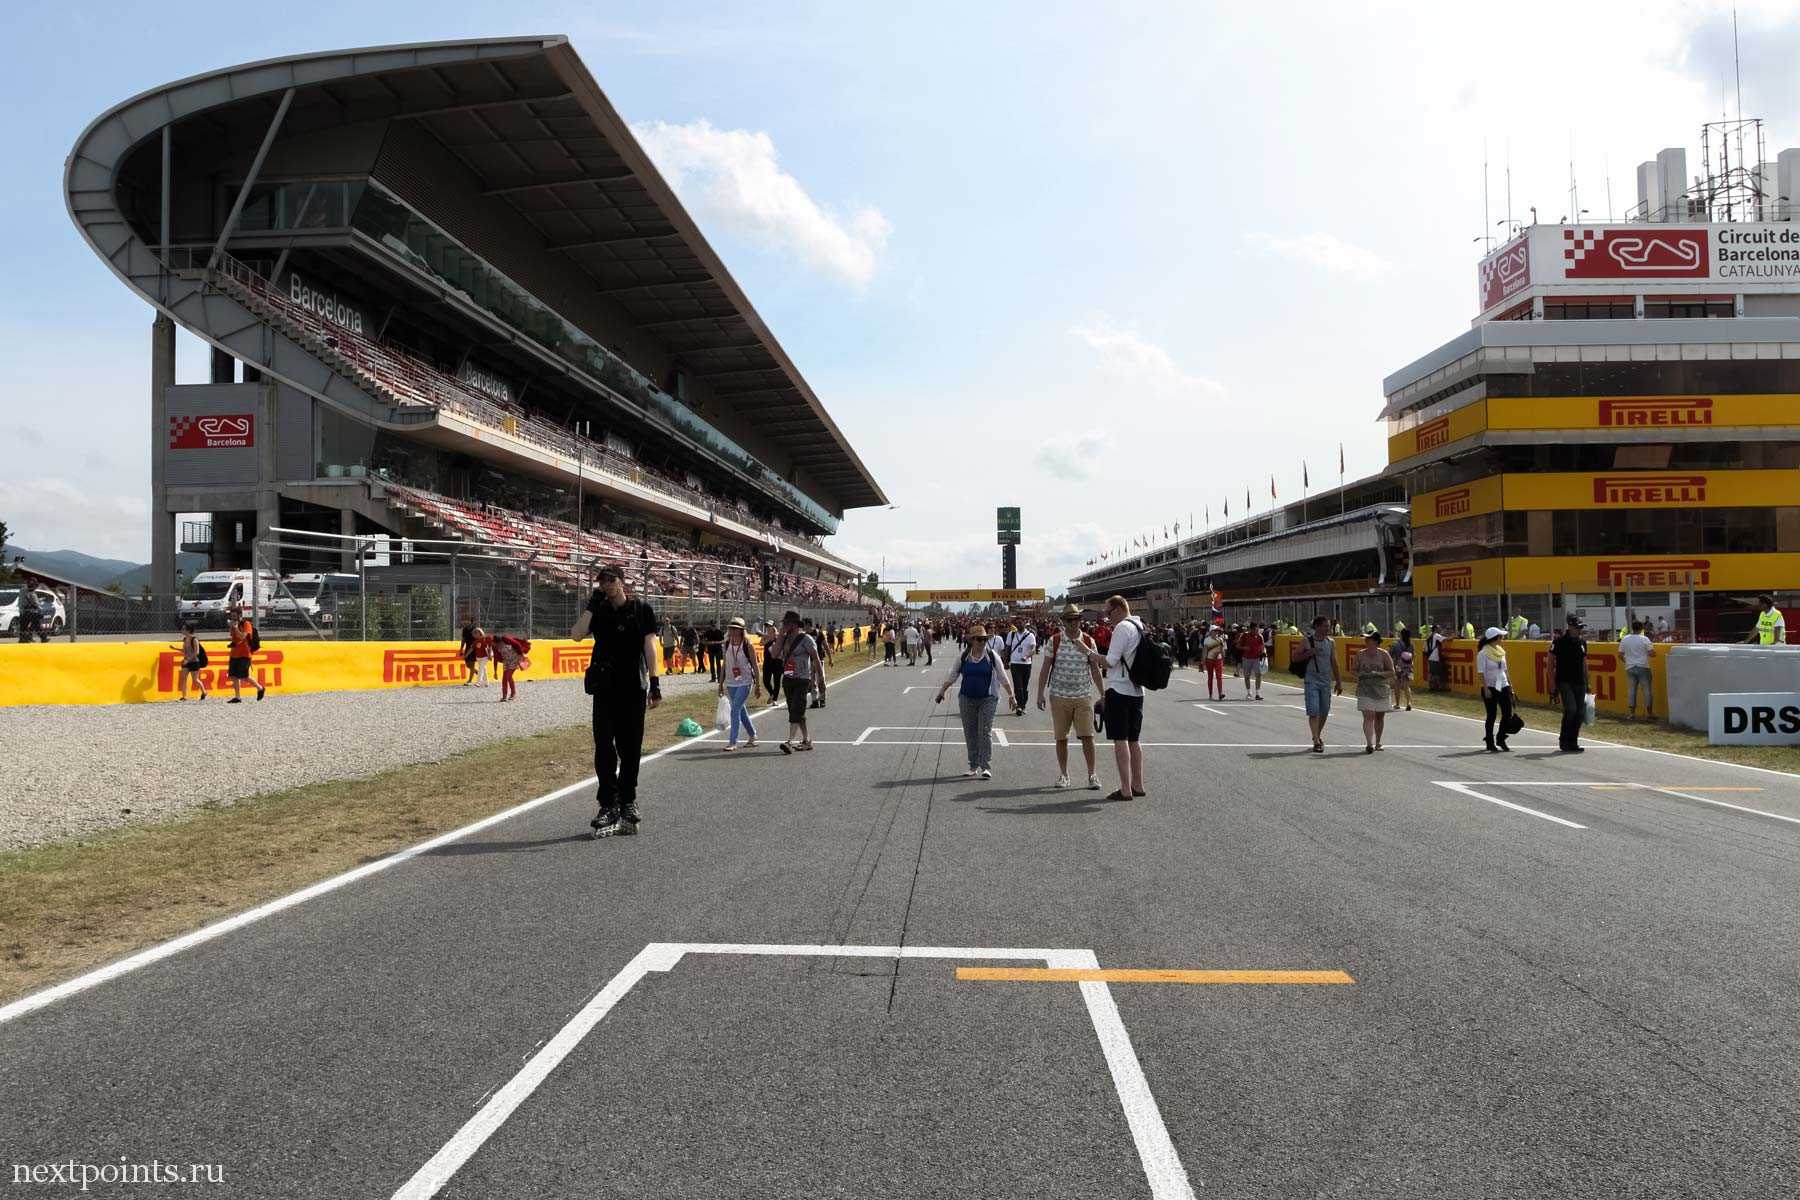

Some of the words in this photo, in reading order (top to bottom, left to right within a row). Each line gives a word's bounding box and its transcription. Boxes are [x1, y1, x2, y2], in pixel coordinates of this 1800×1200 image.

[1718, 229, 1776, 244] Circuit
[1780, 228, 1800, 243] de
[1718, 247, 1800, 261] Barcelona
[1719, 265, 1800, 278] CATALUNYA
[291, 273, 363, 333] Barcelona
[466, 361, 508, 401] Barcelona
[1599, 398, 1713, 426] PIRELLI
[207, 438, 246, 447] Barcelona
[1416, 415, 1450, 452] PIRELLI
[1435, 487, 1470, 518] PIRELLI
[1593, 476, 1707, 503] PIRELLI
[1437, 566, 1472, 592] PIRELLI
[1597, 559, 1710, 587] PIRELLI
[384, 649, 466, 683] PIRELLI
[1724, 706, 1800, 734] DRS
